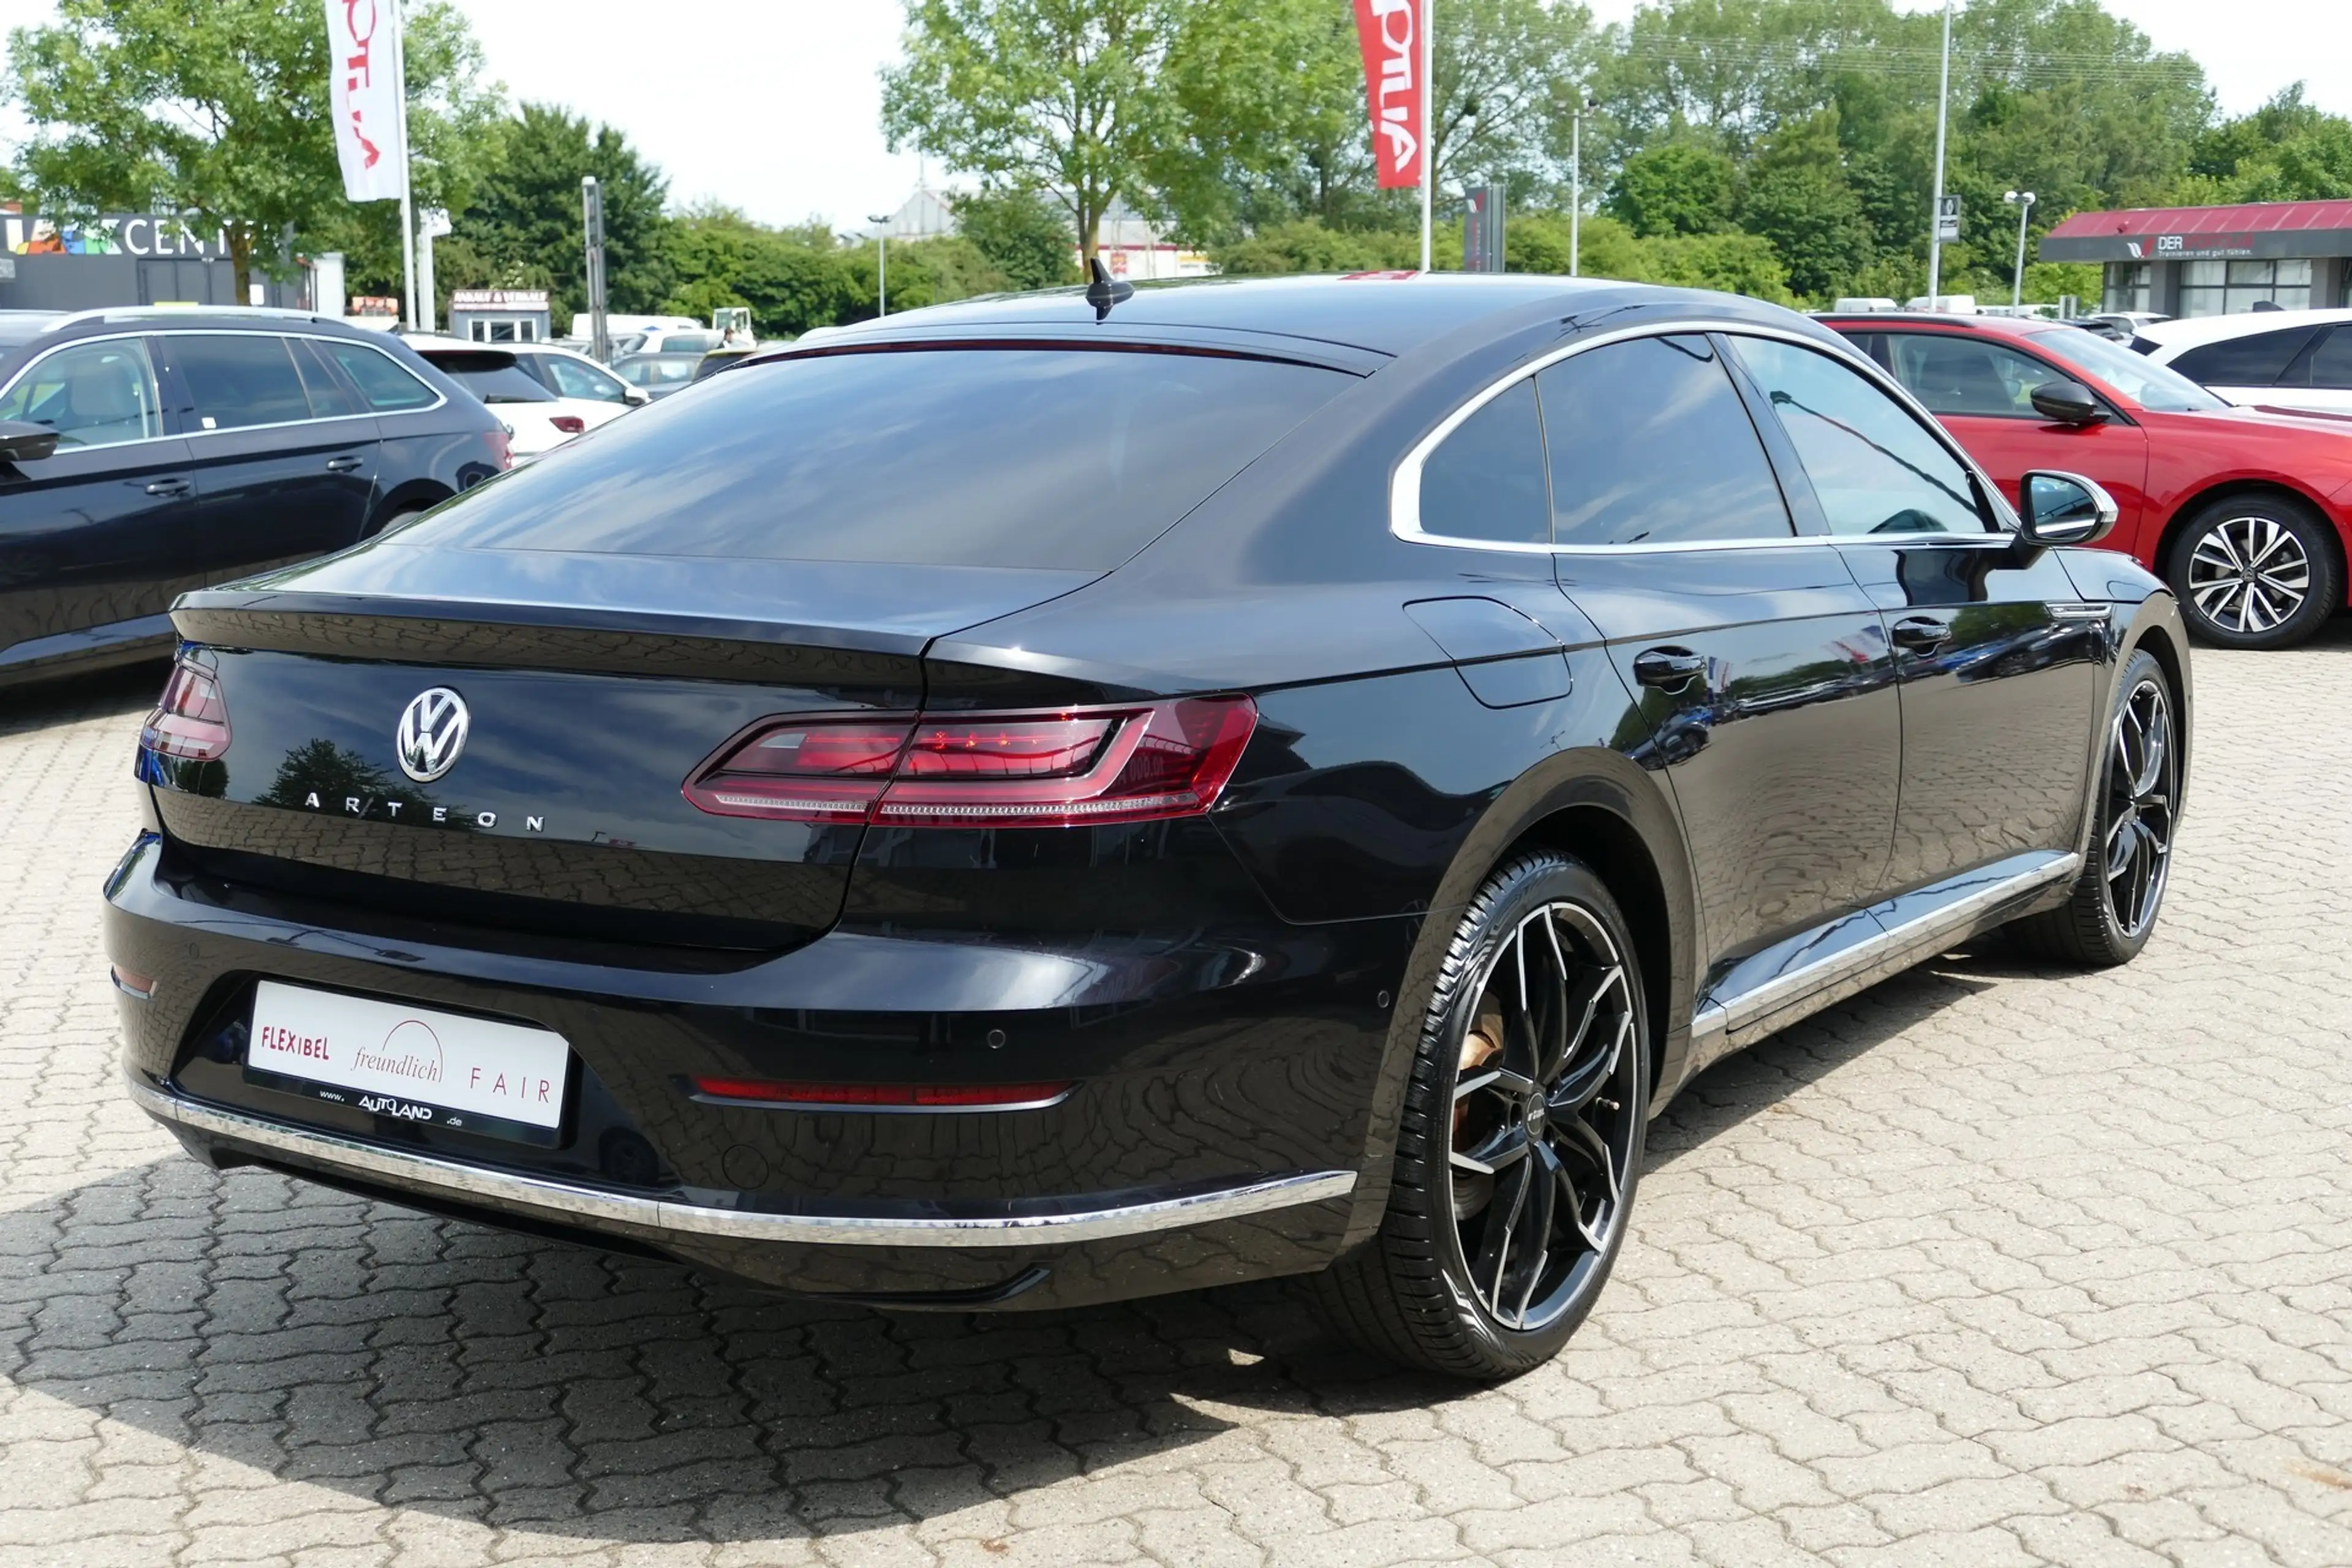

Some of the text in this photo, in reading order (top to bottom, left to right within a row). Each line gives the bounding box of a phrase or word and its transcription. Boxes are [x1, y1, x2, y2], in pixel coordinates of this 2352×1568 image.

[2158, 236, 2182, 250] DER
[305, 792, 545, 832] ARTEON
[262, 1026, 550, 1103] FLEXIBEL freundlich FAIR
[320, 1091, 462, 1126] www. AUTOLAND .de
